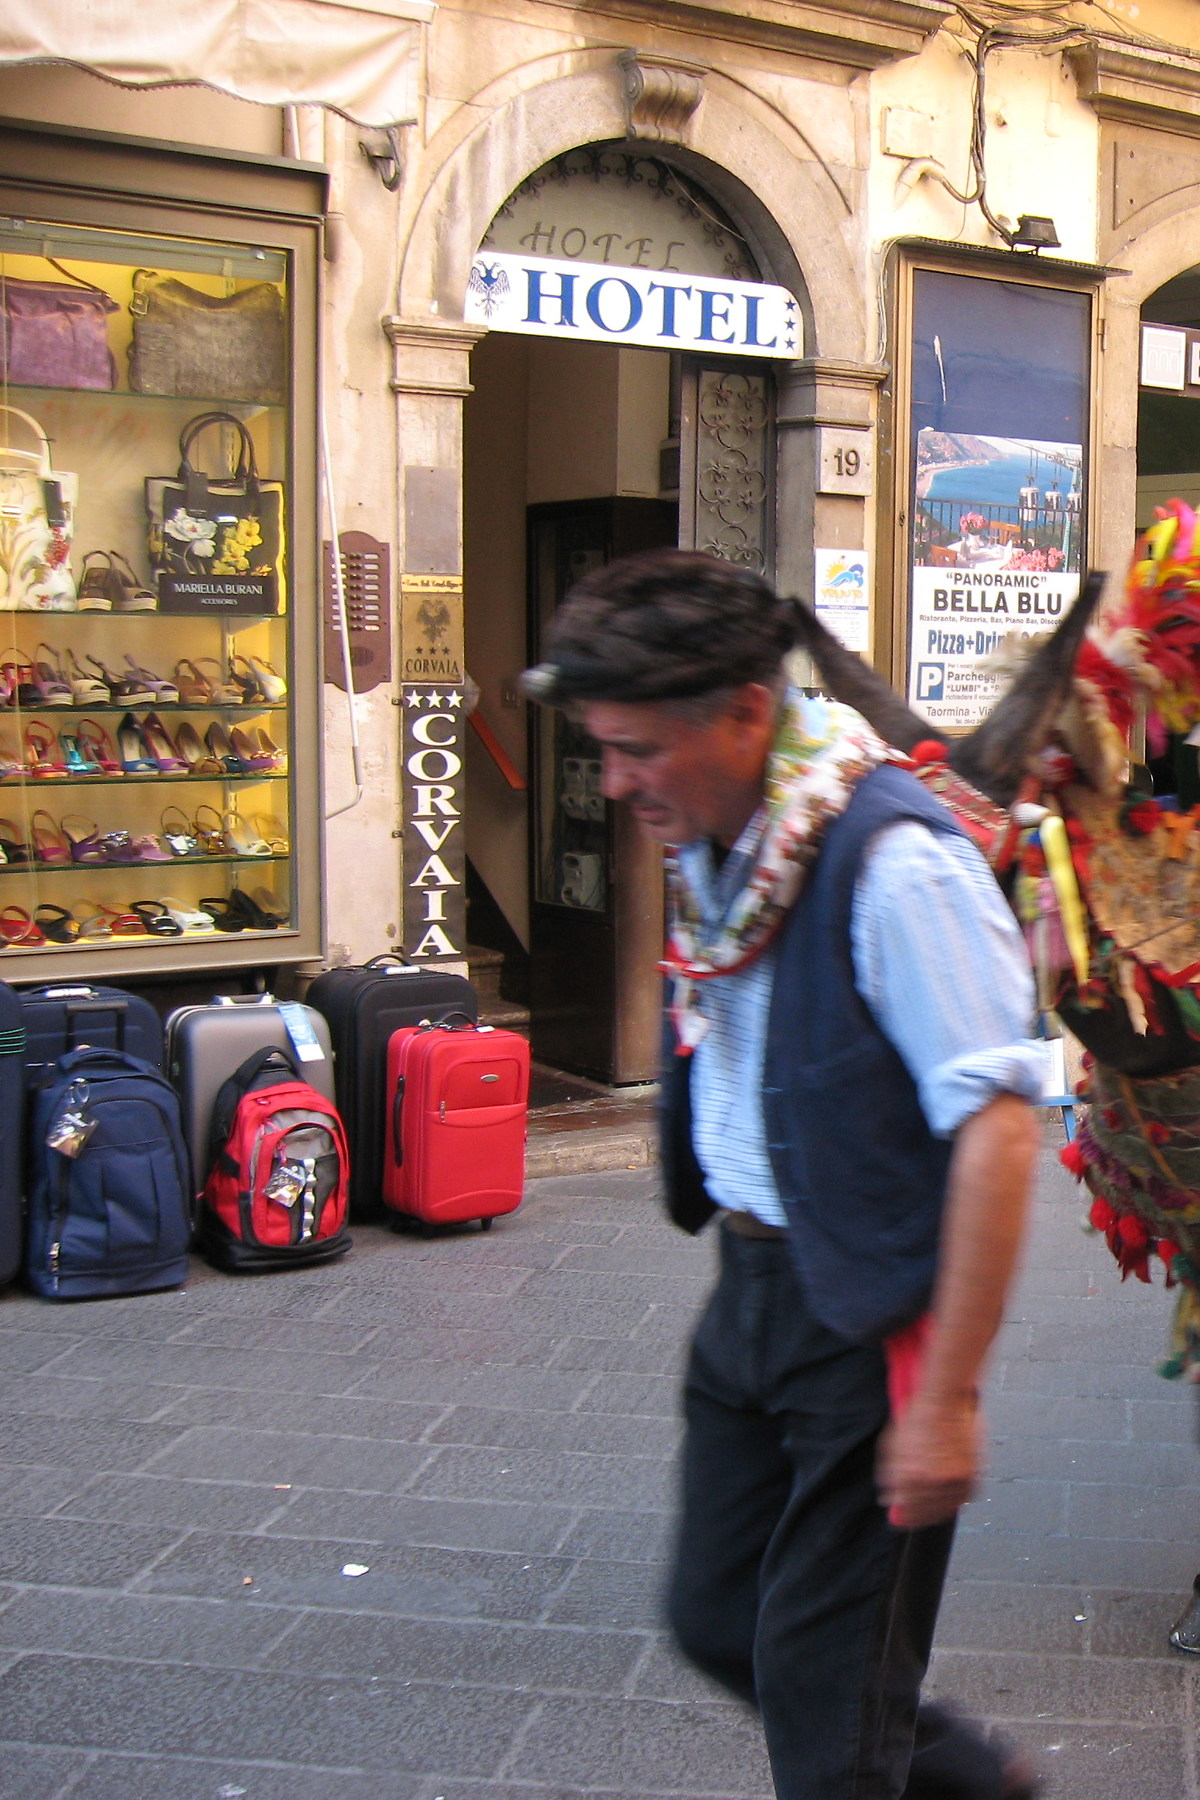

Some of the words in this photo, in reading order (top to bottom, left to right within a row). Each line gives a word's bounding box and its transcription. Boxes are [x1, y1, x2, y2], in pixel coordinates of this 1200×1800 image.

[519, 221, 685, 272] HOTEL
[521, 268, 778, 348] HOTEL
[833, 447, 861, 477] 19
[174, 583, 225, 594] MARIELLA
[225, 584, 263, 595] BURANI
[933, 588, 1009, 613] BELLA
[1018, 592, 1062, 615] BLU
[919, 614, 958, 623] Ristorante,
[960, 616, 988, 624] Pizzeria,
[405, 658, 459, 674] CORVAIA
[920, 666, 943, 697] P
[926, 706, 970, 717] Taormina
[979, 707, 993, 717] Via
[407, 713, 462, 958] CORVAIA
